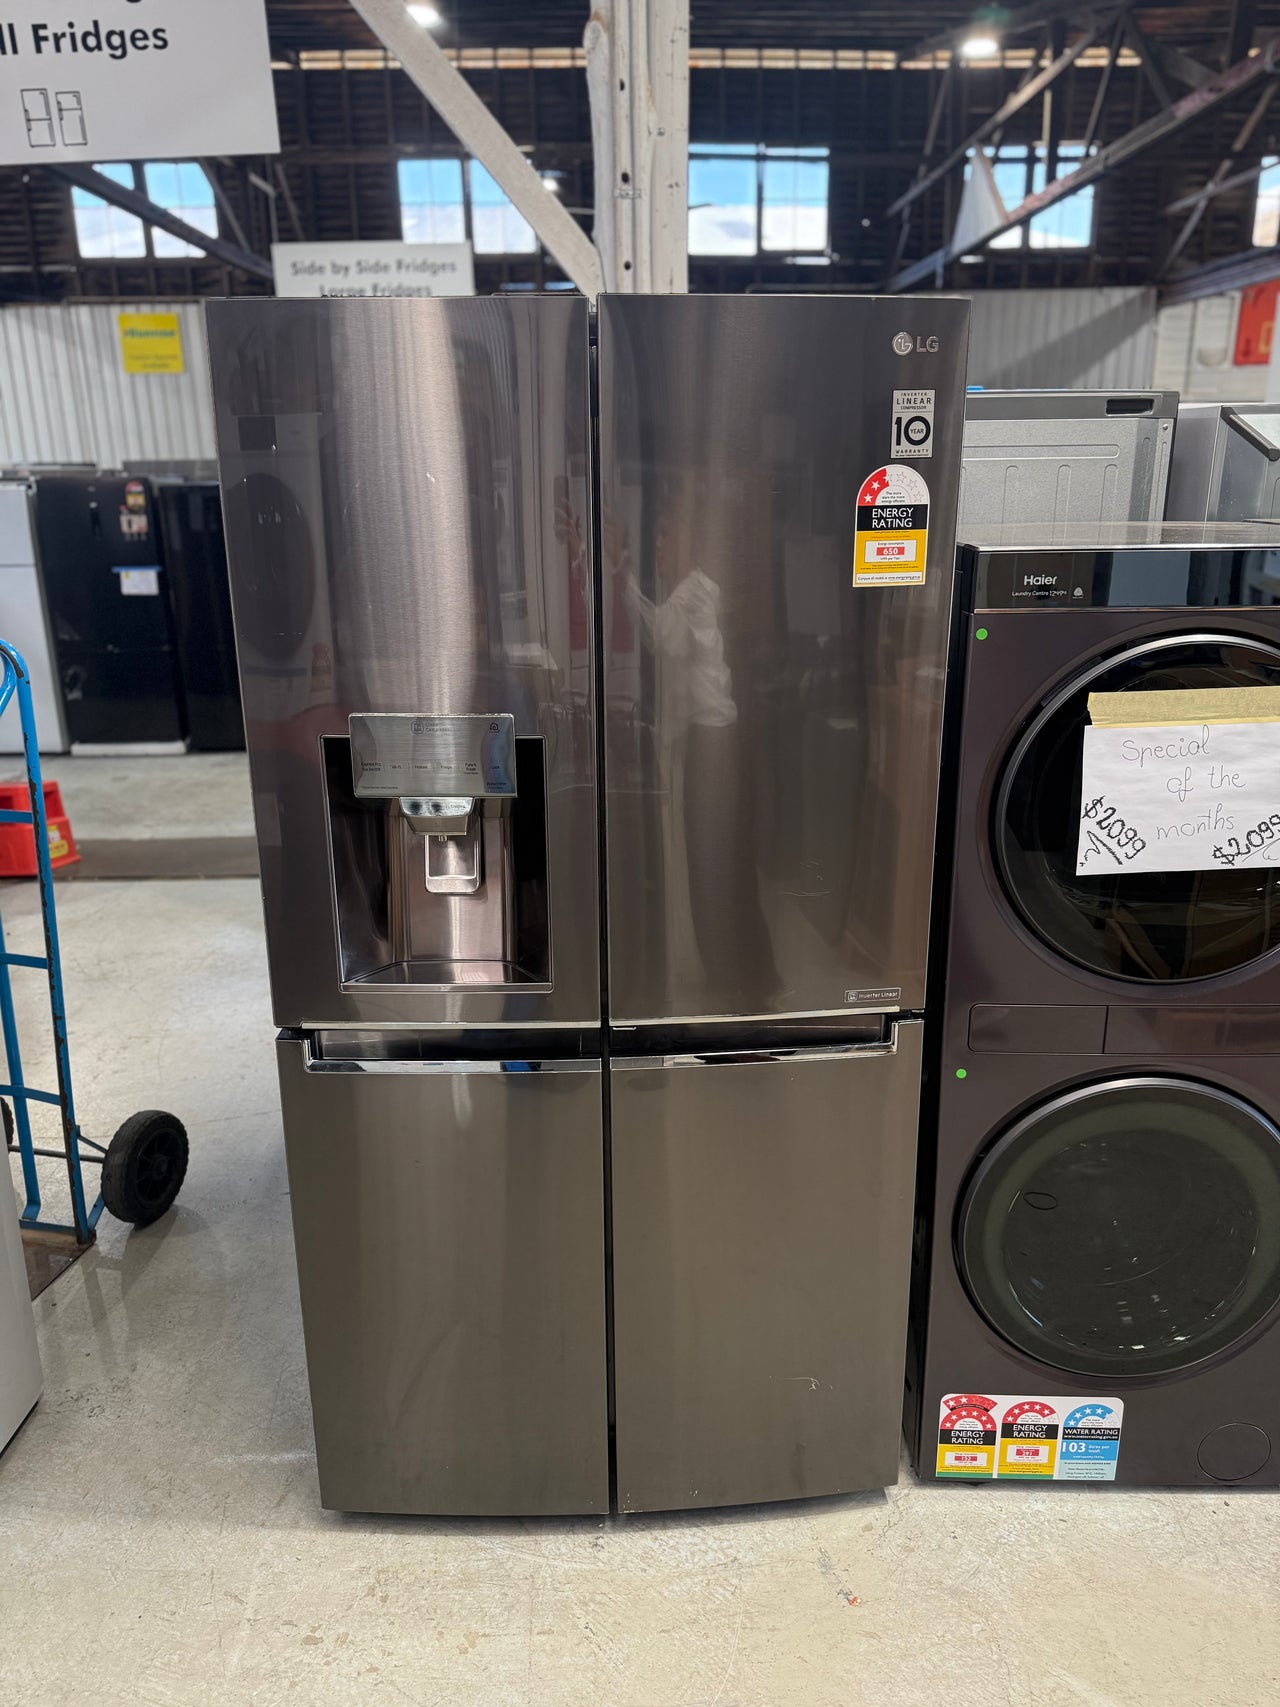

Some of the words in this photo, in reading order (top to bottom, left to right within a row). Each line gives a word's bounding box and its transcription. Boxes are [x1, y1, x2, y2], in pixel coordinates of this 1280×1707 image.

[31, 20, 169, 60] Fridges
[290, 260, 326, 277] Side
[330, 259, 351, 278] by
[355, 259, 391, 276] Side
[395, 258, 457, 277] Fridges
[916, 335, 940, 353] LG
[896, 397, 932, 405] LINEAR
[894, 415, 931, 446] 10
[872, 507, 914, 518] ENERGY
[872, 518, 913, 529] RATING
[883, 547, 899, 555] 650
[1023, 574, 1058, 586] Haier
[1121, 723, 1211, 768] Special
[1166, 766, 1194, 803] of
[1207, 764, 1247, 789] the
[1081, 795, 1147, 860] $2099
[1156, 803, 1236, 840] months
[950, 1430, 985, 1439] ENERGY
[1012, 1424, 1048, 1432] ENERGY
[1061, 1442, 1086, 1453] 103
